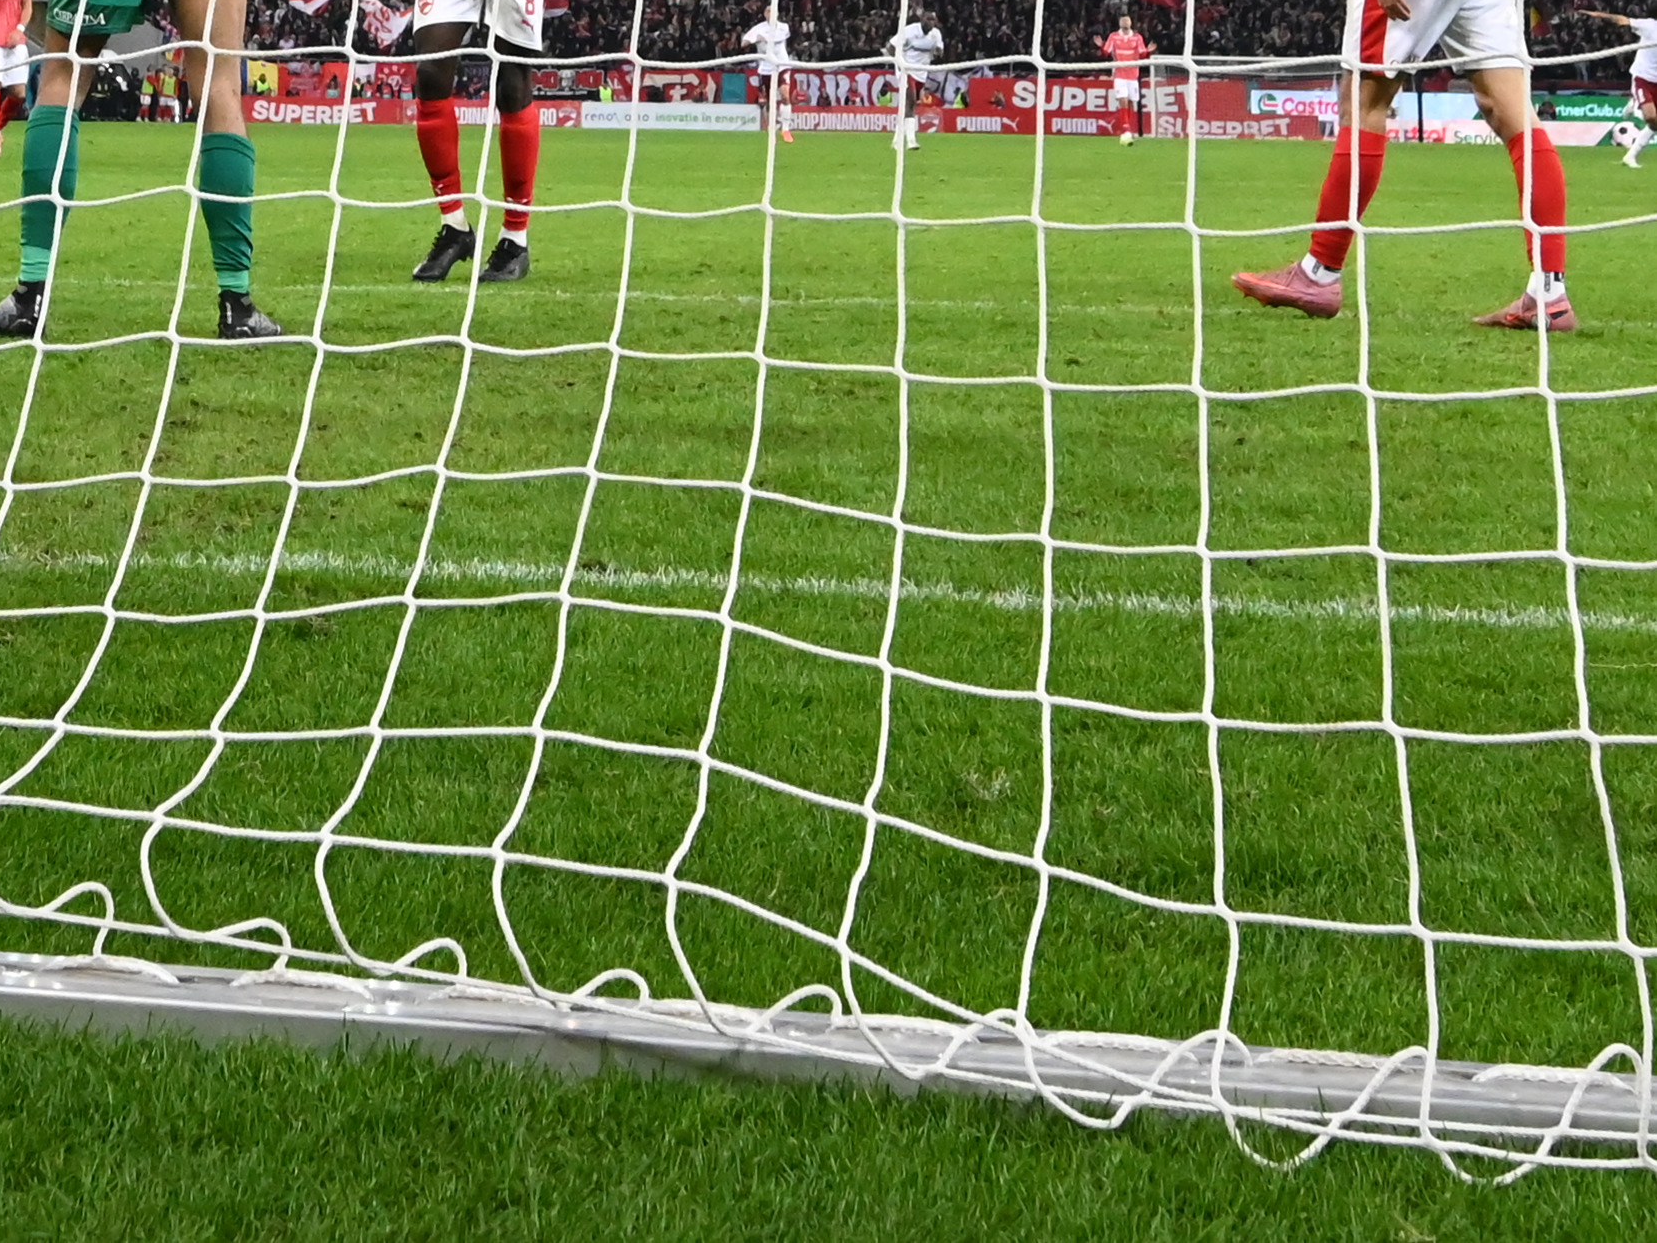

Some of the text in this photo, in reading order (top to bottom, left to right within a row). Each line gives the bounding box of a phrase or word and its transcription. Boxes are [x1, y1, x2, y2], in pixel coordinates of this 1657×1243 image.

[251, 99, 377, 125] SUPERBET
[1281, 96, 1339, 117] Castro
[956, 116, 1002, 132] PUMA
[1051, 117, 1098, 133] PUMA
[1454, 128, 1503, 144] Servic
